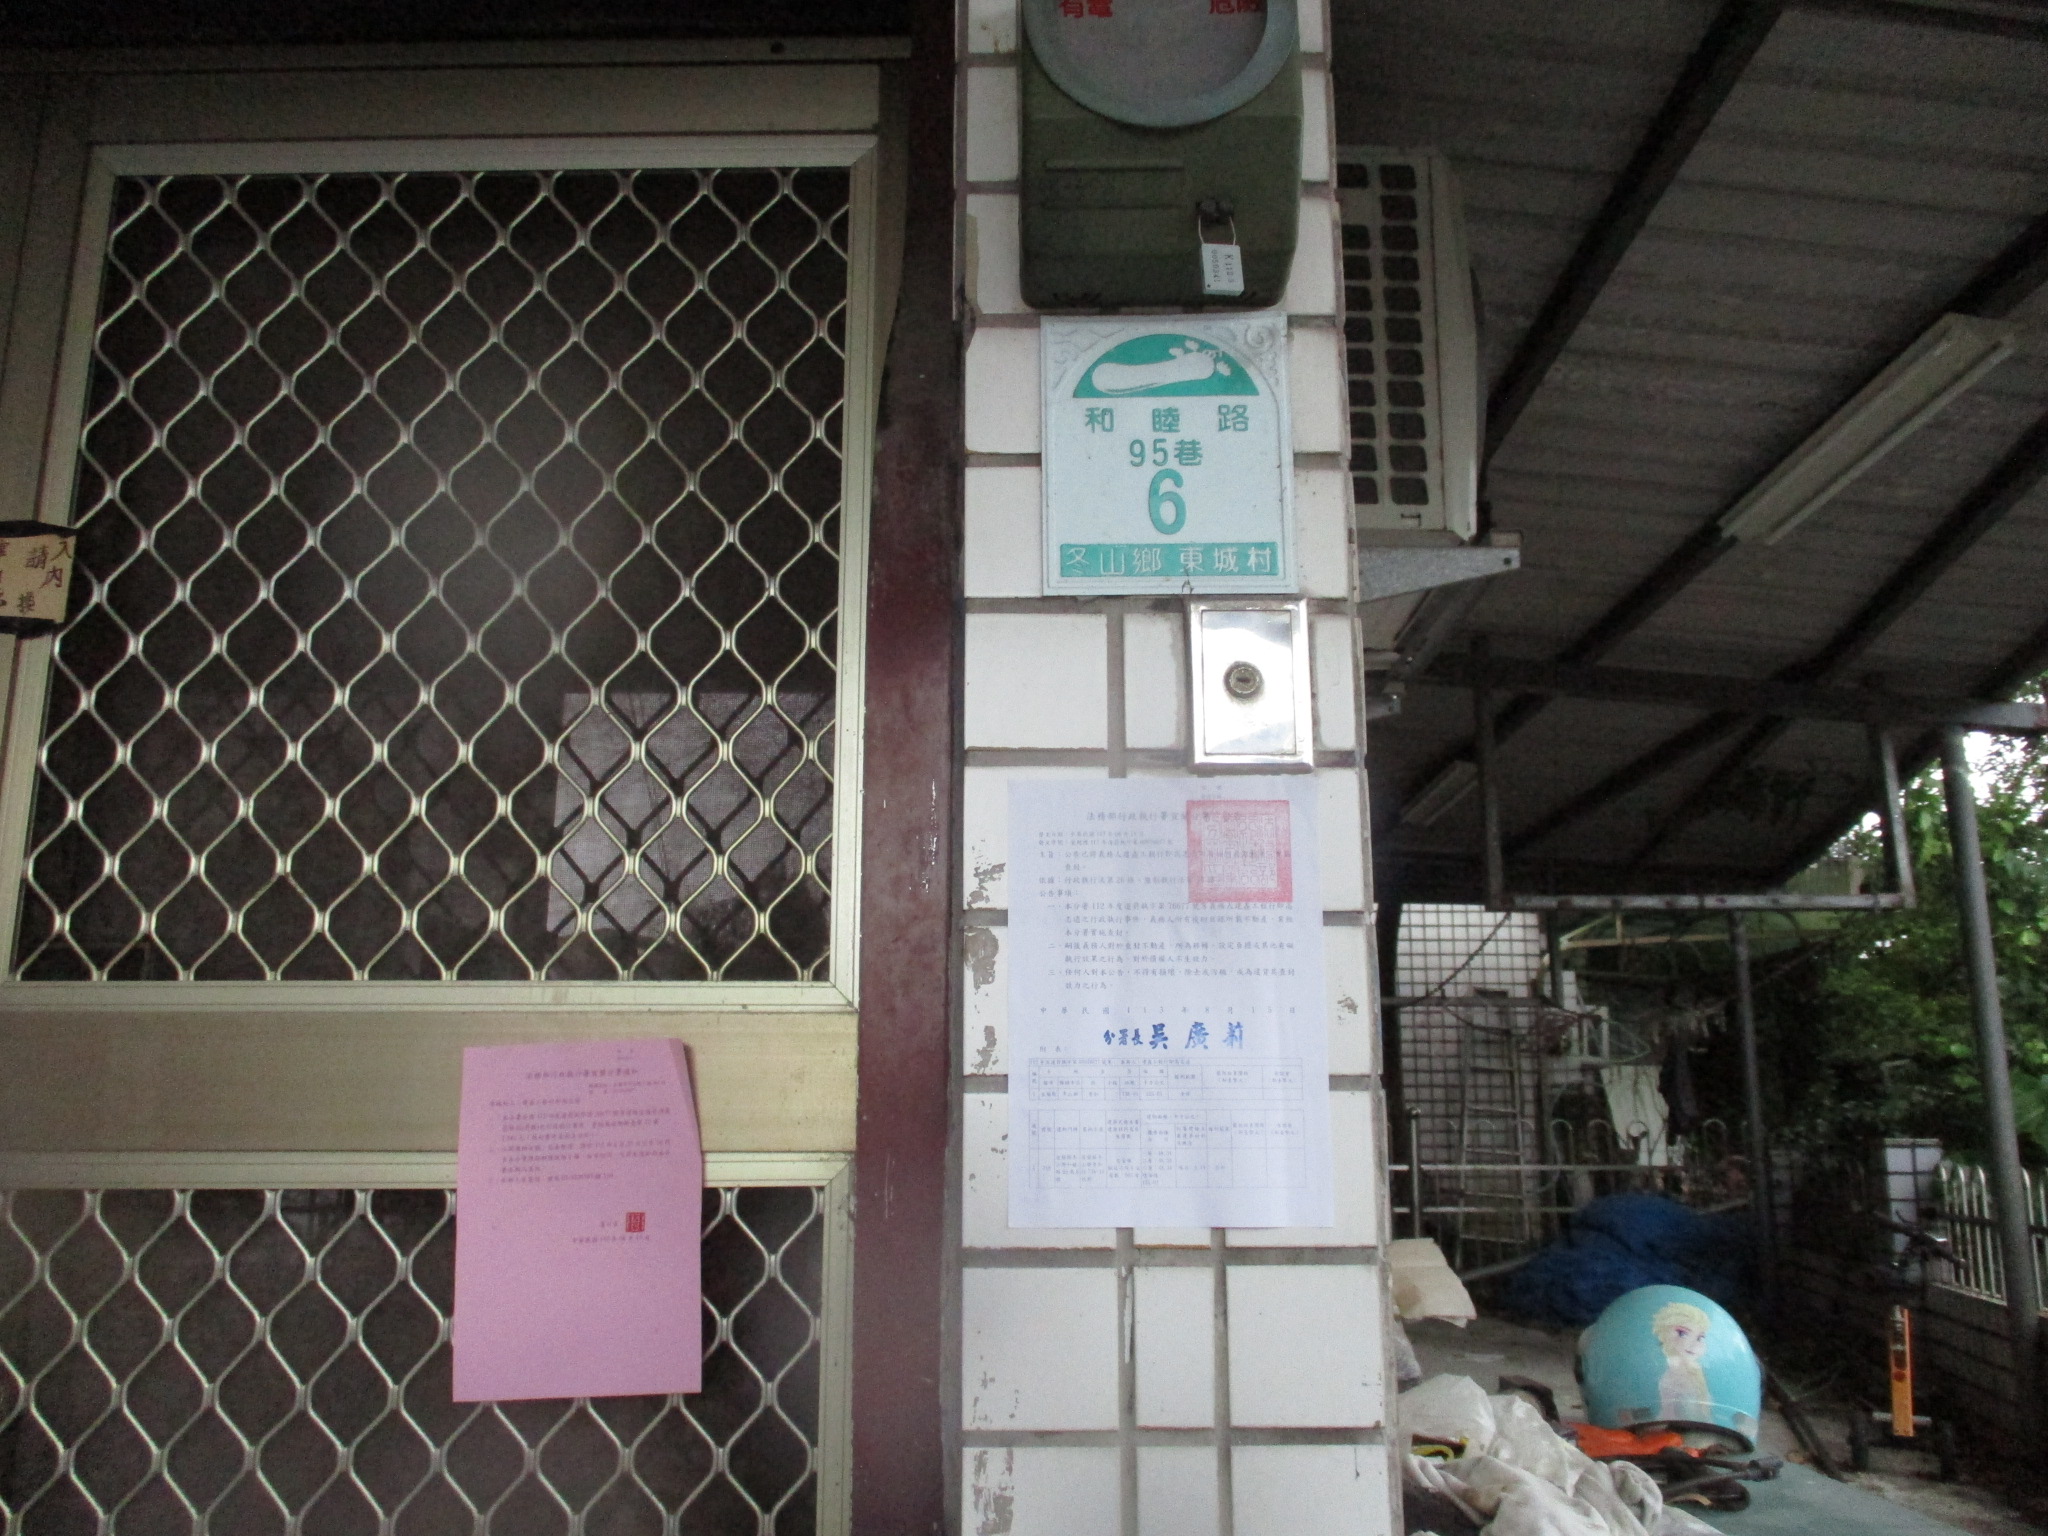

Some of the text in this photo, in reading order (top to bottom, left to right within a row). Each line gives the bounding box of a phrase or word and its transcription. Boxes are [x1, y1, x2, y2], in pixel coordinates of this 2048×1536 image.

[1085, 404, 1250, 433] 和睦路
[1129, 438, 1203, 467] 95巷
[1148, 468, 1187, 535] 6
